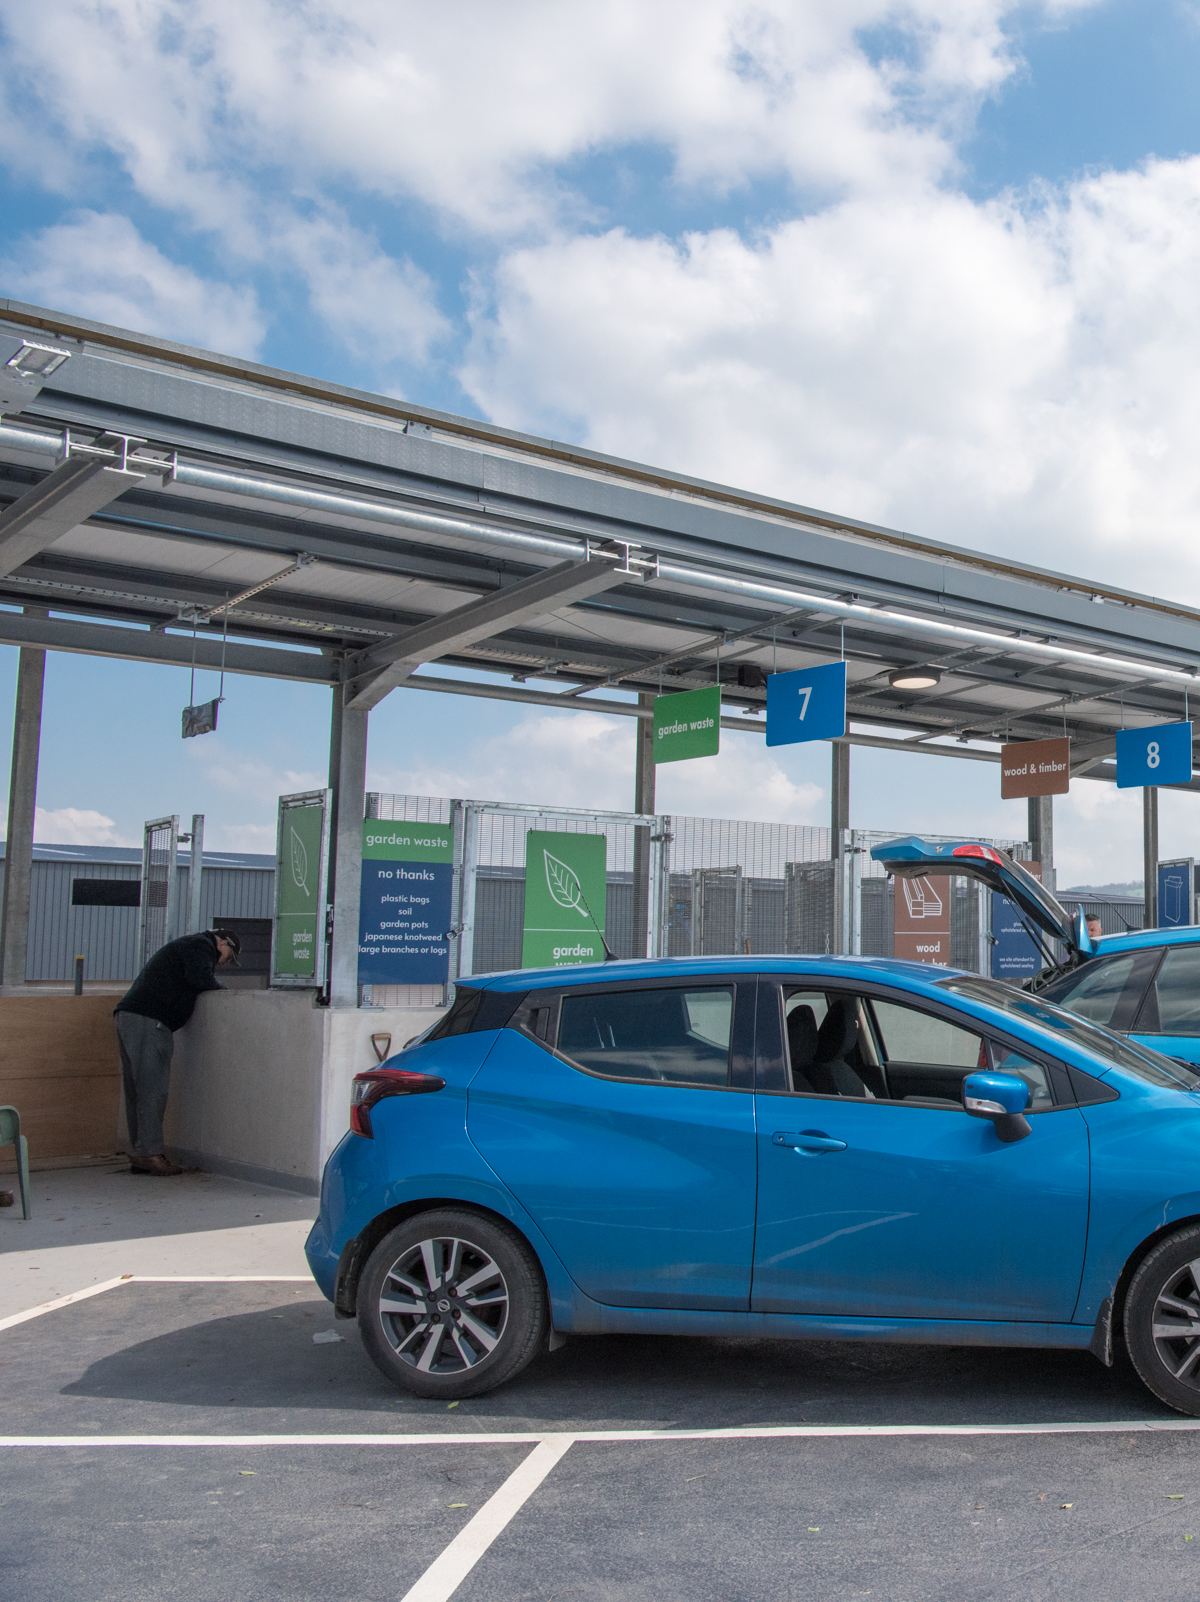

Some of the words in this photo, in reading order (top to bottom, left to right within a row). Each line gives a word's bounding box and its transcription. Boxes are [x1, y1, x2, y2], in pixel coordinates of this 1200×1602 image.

[798, 686, 813, 721] 7
[658, 720, 688, 739] garden
[690, 717, 714, 730] waste
[1146, 741, 1160, 769] 8
[1004, 763, 1027, 777] wood
[1030, 764, 1037, 774] &
[1039, 760, 1067, 773] timber
[366, 833, 411, 847] garden
[413, 837, 449, 848] waste
[378, 870, 393, 879] no
[396, 868, 435, 881] thanks
[381, 894, 408, 904] plastic
[409, 895, 430, 905] bags
[398, 907, 413, 916] soil
[380, 920, 410, 930] garden
[411, 921, 429, 930] pots
[292, 929, 313, 946] garden
[364, 932, 403, 942] japanese
[404, 933, 442, 942] knotweed
[358, 944, 381, 955] large
[381, 945, 419, 954] branches
[430, 946, 447, 956] logs
[552, 943, 594, 959] garden
[916, 940, 941, 953] wood
[293, 947, 310, 960] waste
